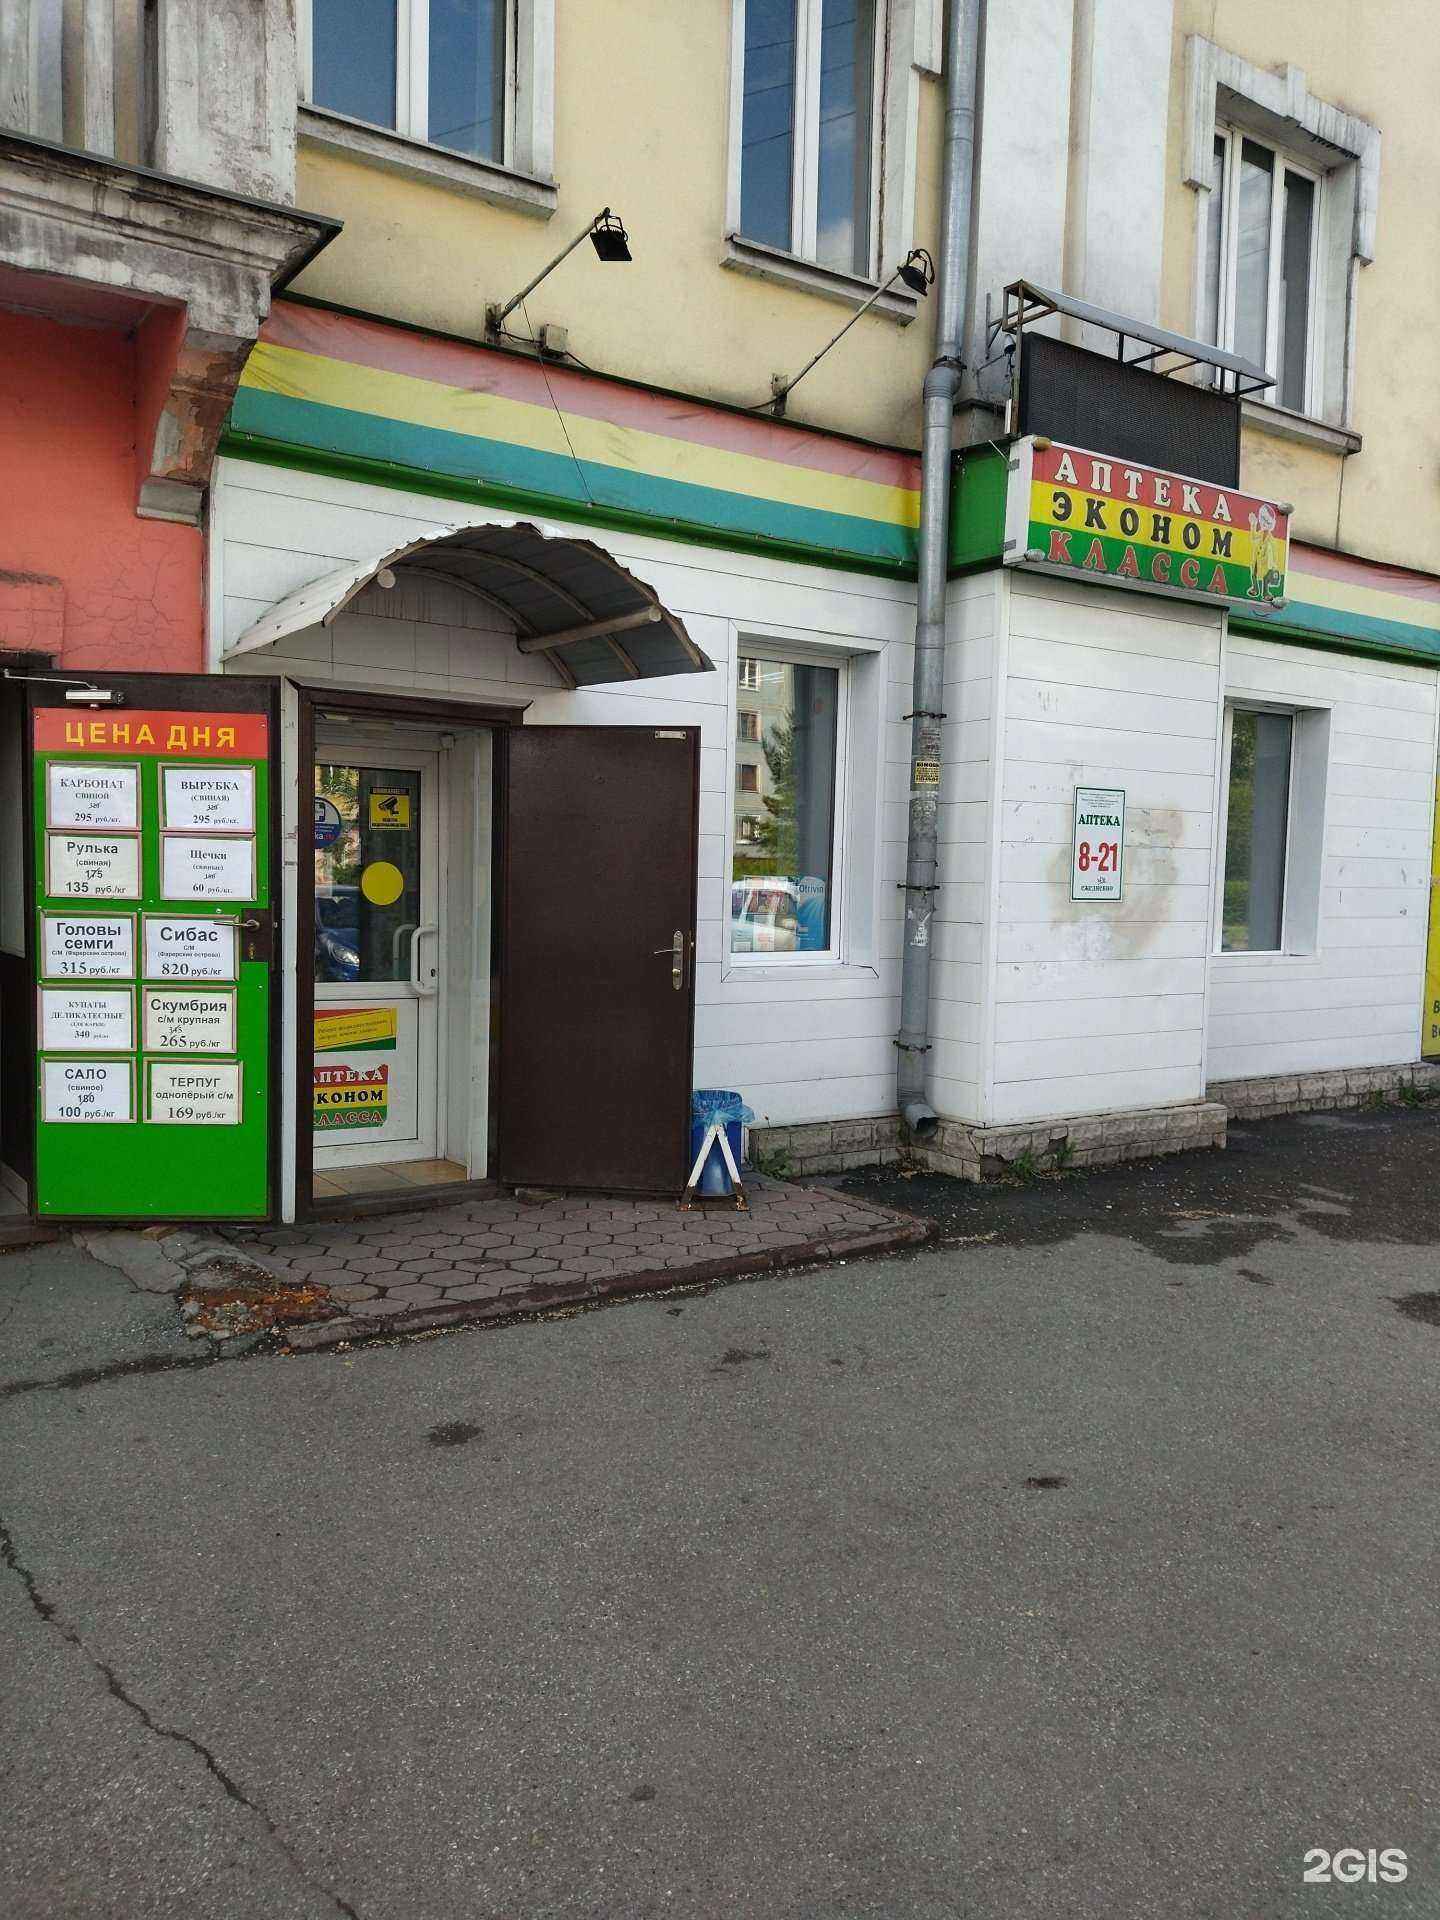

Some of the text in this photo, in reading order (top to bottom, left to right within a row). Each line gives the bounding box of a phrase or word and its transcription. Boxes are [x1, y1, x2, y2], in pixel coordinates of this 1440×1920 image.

[1053, 451, 1233, 523] АПТЕКА
[1051, 490, 1234, 559] ЭКОНОМ
[1046, 528, 1229, 596] КЛАССА
[65, 720, 236, 750] ЦЕНА ДНЯ
[60, 778, 126, 789] КАРБОНАТ
[181, 781, 240, 791] ВЫРУБКА
[74, 812, 92, 822] 295
[192, 815, 210, 824] 295
[1078, 813, 1121, 827] АПТЕКА
[67, 841, 119, 856] Рулька
[190, 849, 227, 861] Щечки
[1078, 840, 1119, 872] 8-21
[76, 858, 112, 867] (свиная)
[86, 868, 103, 880] 175
[65, 881, 127, 895] 135 руб./кг
[192, 883, 204, 892] 60
[798, 883, 824, 894] Otrivin
[57, 922, 121, 936] Головы
[160, 926, 219, 942] Сибас
[65, 939, 114, 950] семги
[59, 961, 121, 976] 315 руб./кг
[161, 962, 223, 977] 820 руб./кг
[68, 1001, 107, 1009] КУПАТЫ
[150, 998, 228, 1014] Скумбрия
[50, 1011, 126, 1020] ДЕЛИКАТЕСНЫЕ
[177, 1015, 221, 1026] крупная
[74, 1029, 90, 1039] 340
[159, 1034, 221, 1049] 265 руб./кг
[64, 1068, 107, 1080] САЛО
[67, 1083, 104, 1092] (свиное)
[169, 1077, 222, 1088] ТЕРПУГ
[77, 1093, 96, 1104] 180
[314, 1089, 384, 1105] КОНОМ
[58, 1106, 116, 1119] 100 руб./кг
[168, 1107, 194, 1119] 169
[314, 1111, 385, 1127] ЛАССА
